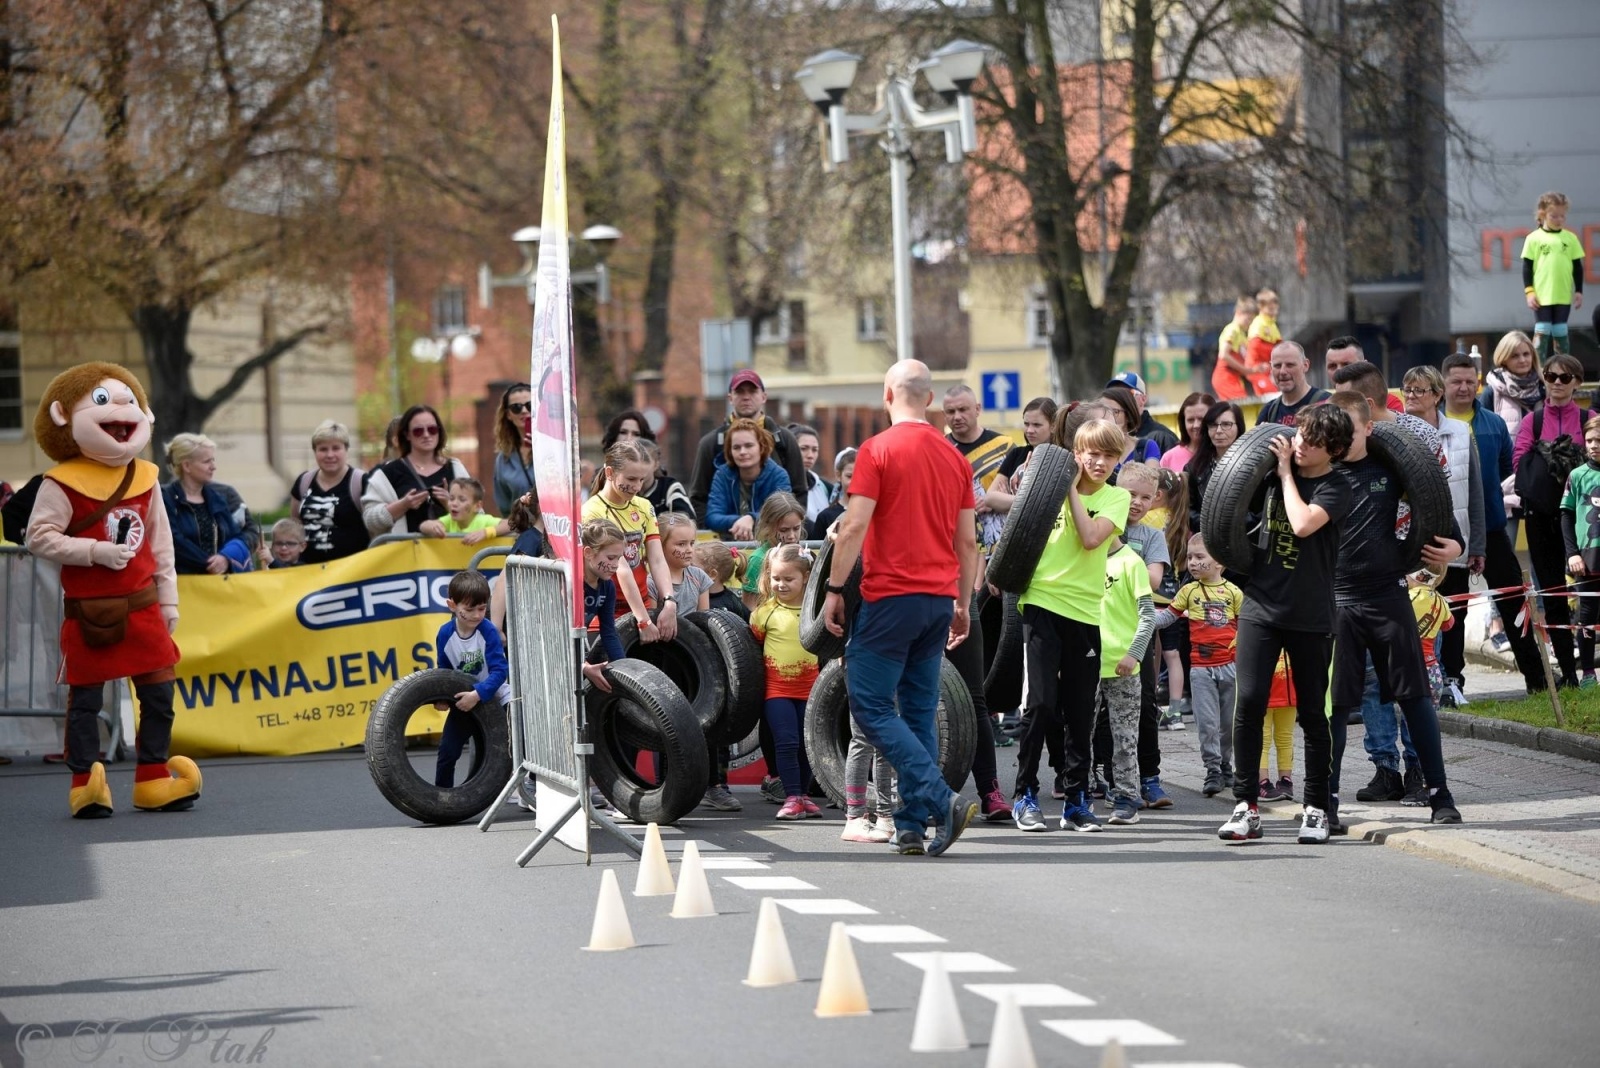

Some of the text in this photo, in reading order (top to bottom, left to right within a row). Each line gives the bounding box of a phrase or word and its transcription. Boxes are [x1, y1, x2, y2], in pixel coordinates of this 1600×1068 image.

[175, 648, 399, 710] WYNAJEM
[256, 713, 290, 728] TEL.
[293, 708, 322, 722] +48
[326, 702, 356, 717] 792
